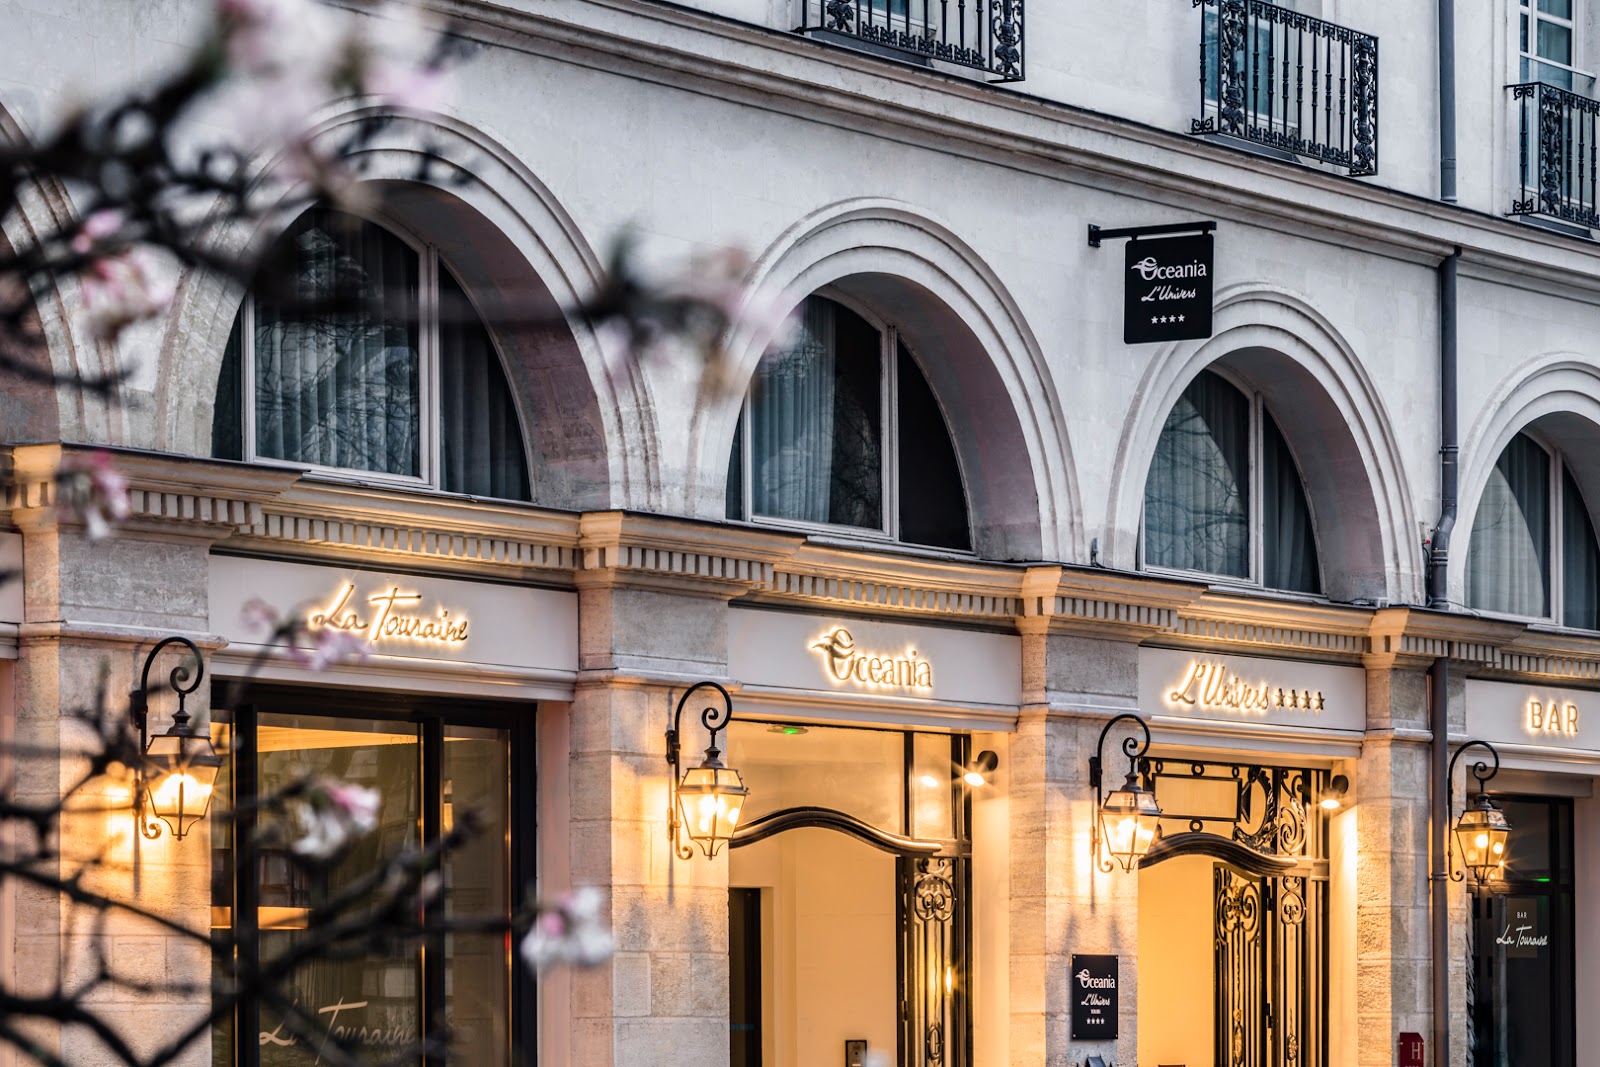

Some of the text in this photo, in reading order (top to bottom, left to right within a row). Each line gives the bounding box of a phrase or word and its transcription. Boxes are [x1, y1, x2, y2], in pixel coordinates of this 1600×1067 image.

[1131, 257, 1207, 280] Oceania
[1141, 285, 1196, 302] L'Univers
[311, 584, 468, 641] La Touraine
[812, 628, 932, 688] Oceania
[1170, 664, 1269, 710] L'Univers
[1530, 701, 1578, 733] BAR
[1516, 911, 1527, 919] BAR
[1496, 924, 1514, 945] La
[1075, 968, 1115, 989] Oceania
[1411, 1041, 1421, 1060] H
